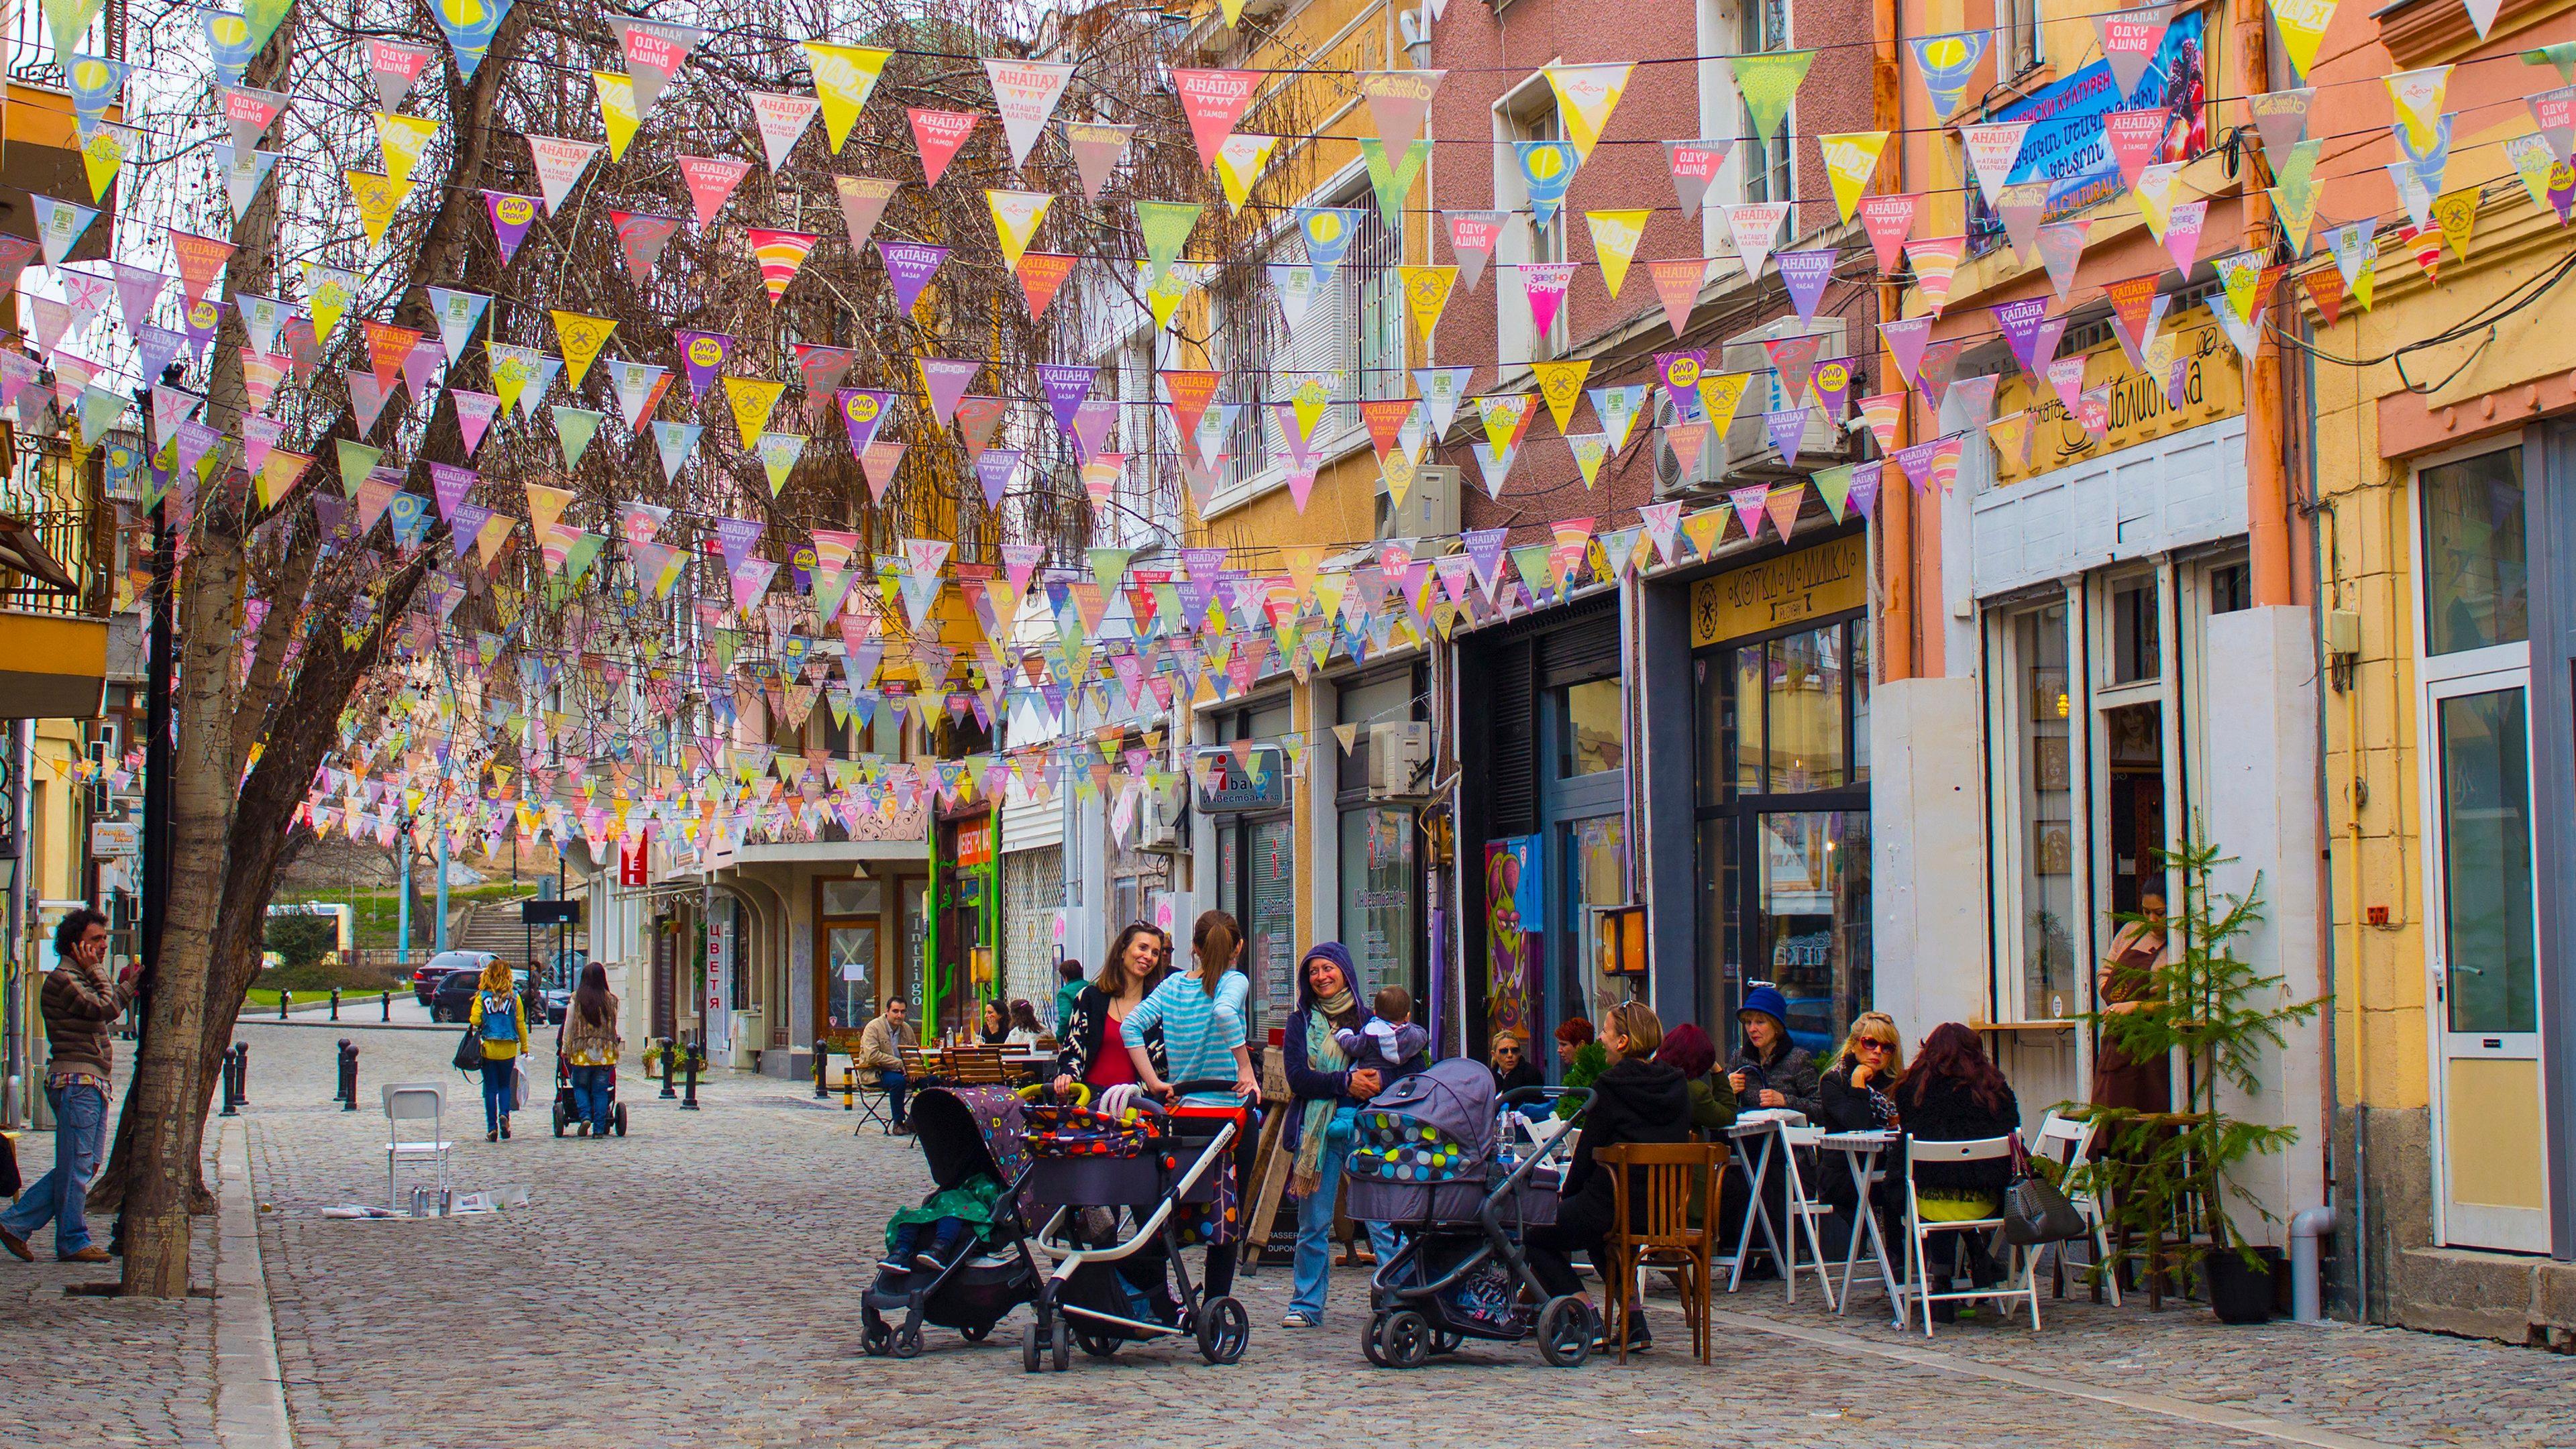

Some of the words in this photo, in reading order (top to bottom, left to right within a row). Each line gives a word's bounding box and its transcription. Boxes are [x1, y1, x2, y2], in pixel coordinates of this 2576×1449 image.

[2058, 70, 2110, 111] КУЛТУРЕН
[502, 201, 529, 212] DND
[502, 210, 527, 221] TRAVEL
[888, 249, 938, 264] КАПАНА
[1017, 257, 1067, 272] КАПАНА
[2217, 253, 2265, 280] BOOM
[306, 265, 361, 292] BOOM
[901, 271, 920, 280] БАЗАР
[2112, 281, 2155, 301] КАПАНА
[2000, 303, 2044, 323] КАПАНА
[694, 340, 718, 352] DND
[490, 345, 542, 367] BOOM
[694, 351, 717, 362] TRAVEL
[1043, 368, 1089, 382] КАПАНА
[1672, 363, 1693, 376] DND
[1821, 369, 1843, 381] DND
[1169, 375, 1215, 390] КАПАНА
[1289, 372, 1342, 391] BOOM
[1672, 374, 1694, 382] TRAVEL
[1822, 378, 1843, 387] TRAVEL
[1058, 392, 1075, 400] БАЗАР
[852, 398, 874, 411] DND
[1364, 403, 1407, 417] КАПАНА
[1481, 396, 1527, 416] BOOM
[852, 408, 874, 419] TRAVEL
[710, 924, 720, 1009] ЦВЕТЯ
[911, 918, 922, 1006] Intrigo
[1214, 1130, 1232, 1152] COSATTO
